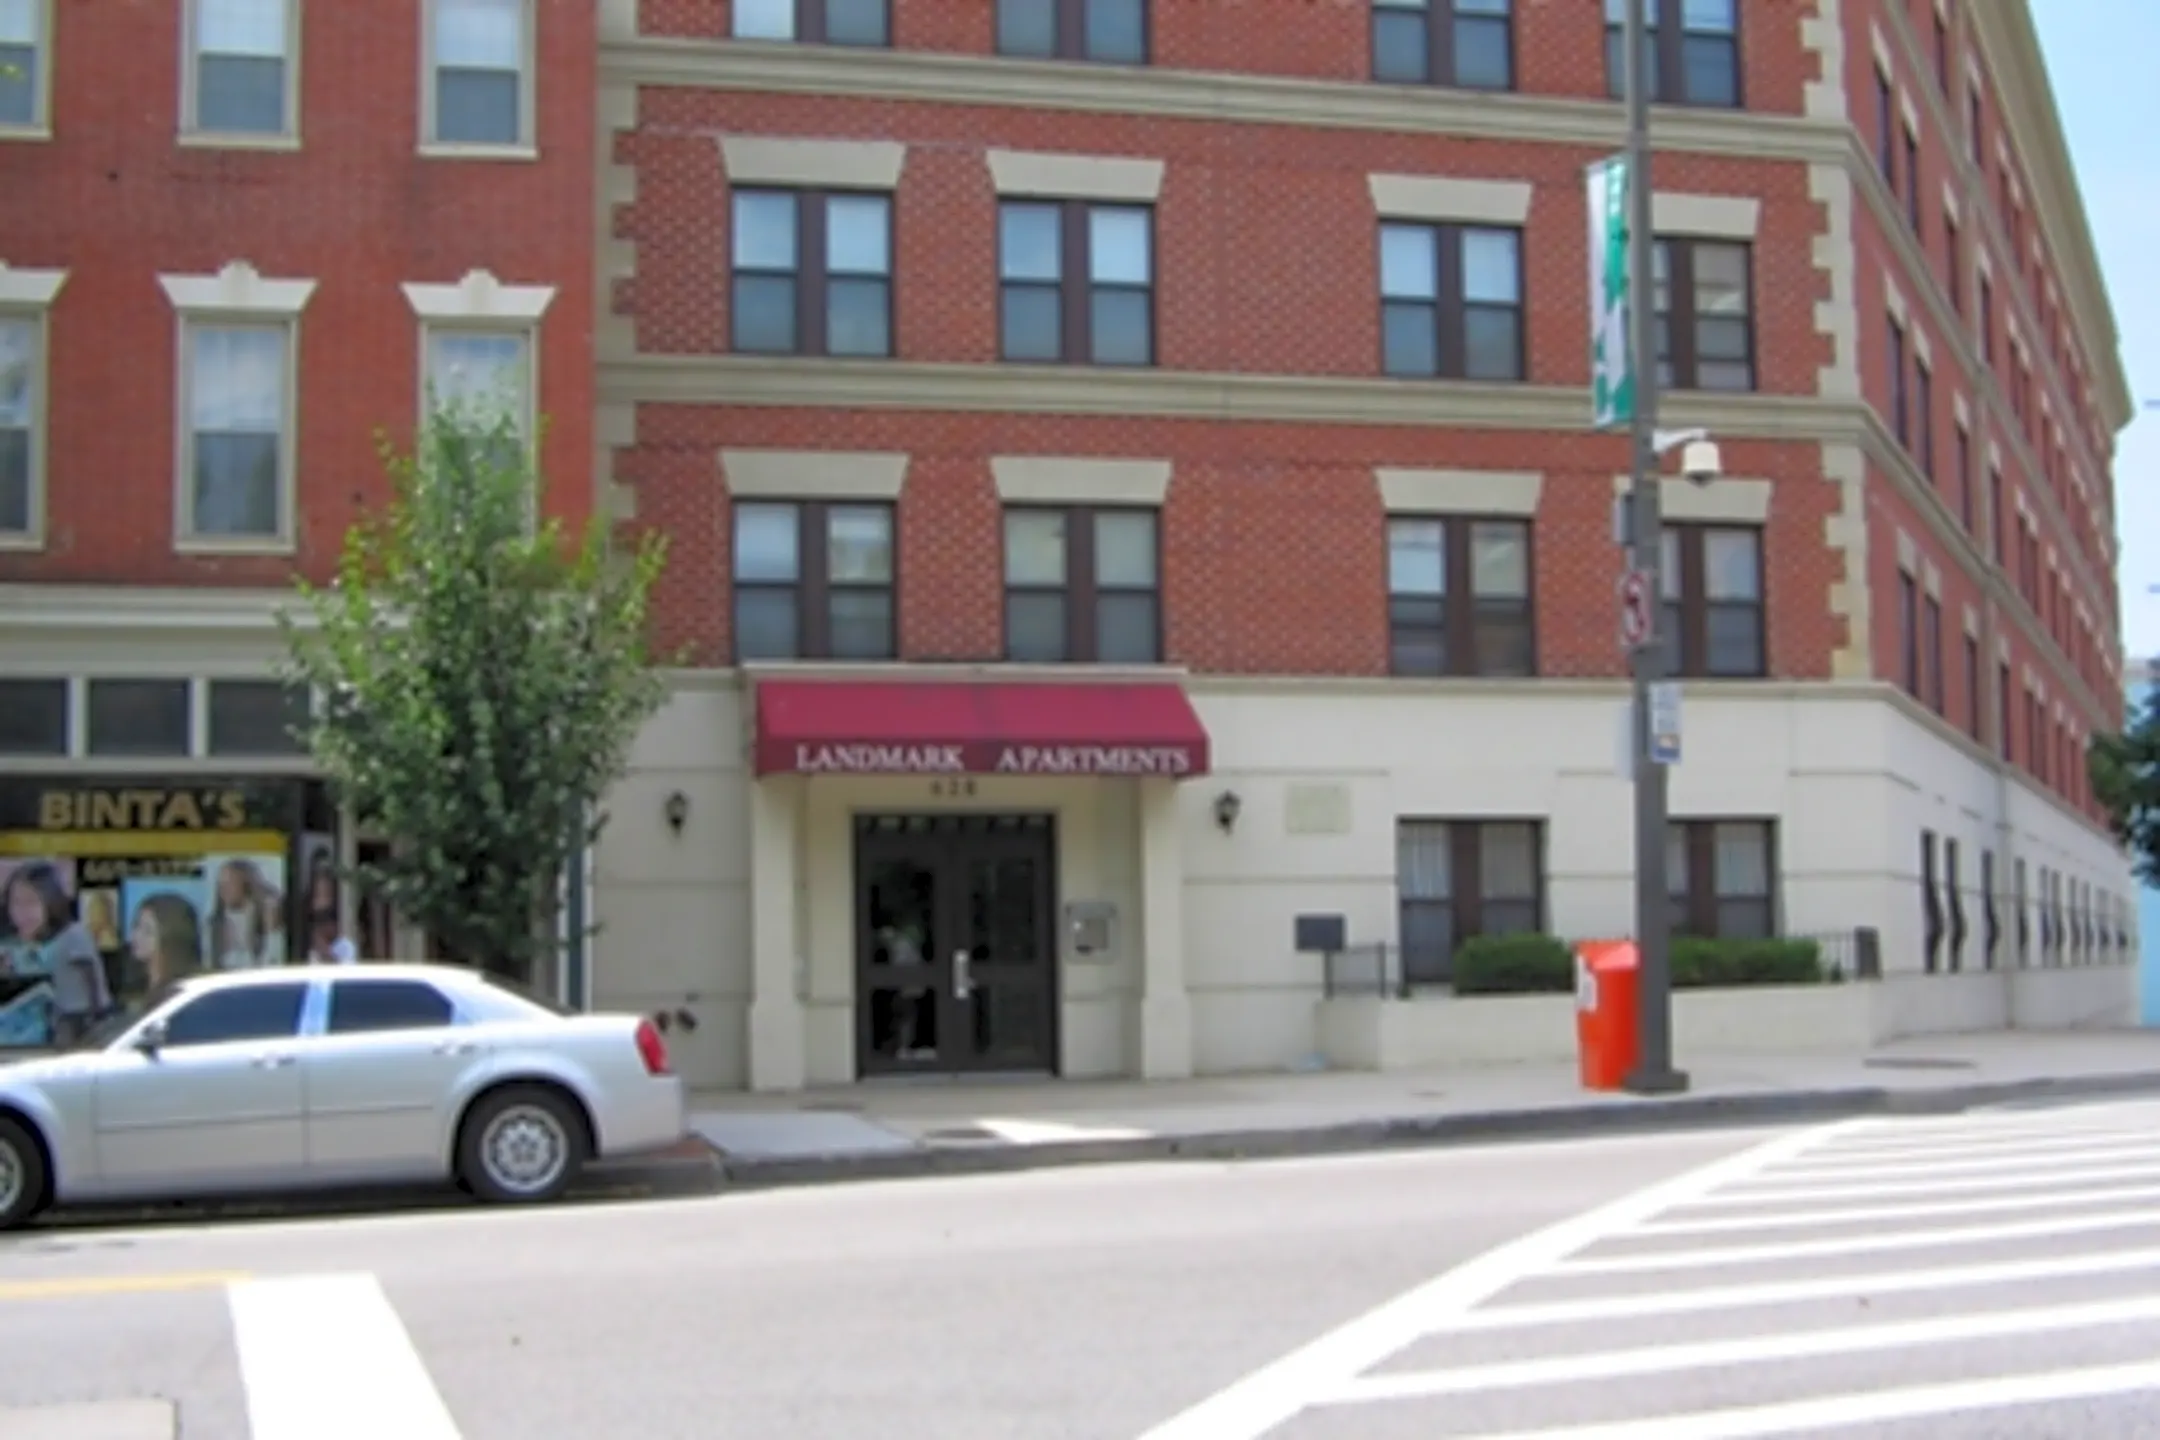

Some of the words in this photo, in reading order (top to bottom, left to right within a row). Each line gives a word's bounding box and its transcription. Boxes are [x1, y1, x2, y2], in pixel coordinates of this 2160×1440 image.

[796, 743, 964, 773] LANDMARK
[996, 744, 1190, 774] APARTMENTS
[40, 790, 246, 829] BINTA'S
